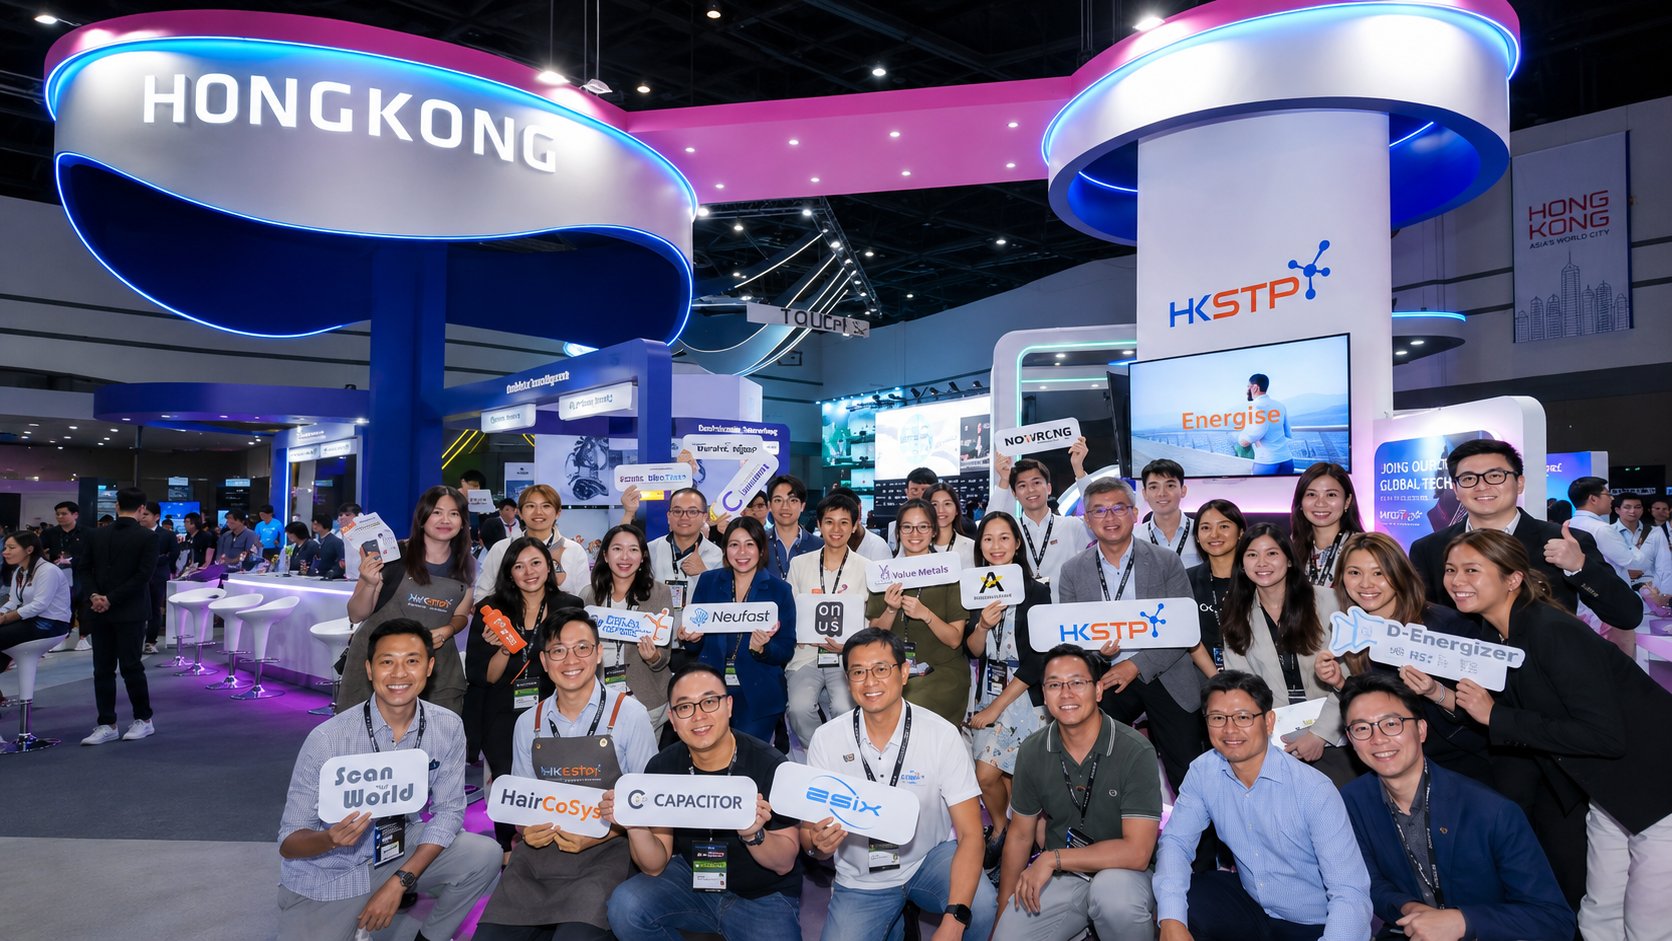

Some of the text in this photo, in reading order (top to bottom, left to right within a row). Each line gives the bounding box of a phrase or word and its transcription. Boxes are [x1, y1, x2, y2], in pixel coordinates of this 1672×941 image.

[1528, 190, 1609, 221] HONG
[1529, 209, 1610, 240] KONG
[1529, 229, 1610, 250] ASIA'S WORLD CITY
[1169, 276, 1300, 328] HKSTP
[1181, 405, 1281, 431] Energise
[1380, 477, 1453, 491] GLOBAL TECH
[892, 565, 949, 580] Value Metals
[711, 609, 770, 623] Neufast
[818, 603, 841, 616] on
[818, 620, 839, 632] us
[1059, 621, 1148, 642] HKSTP
[1386, 623, 1520, 663] D-Energizer
[334, 766, 393, 786] Scan
[343, 783, 414, 809] World
[500, 788, 602, 821] HairCoSys
[654, 793, 742, 810] CAPACITOR
